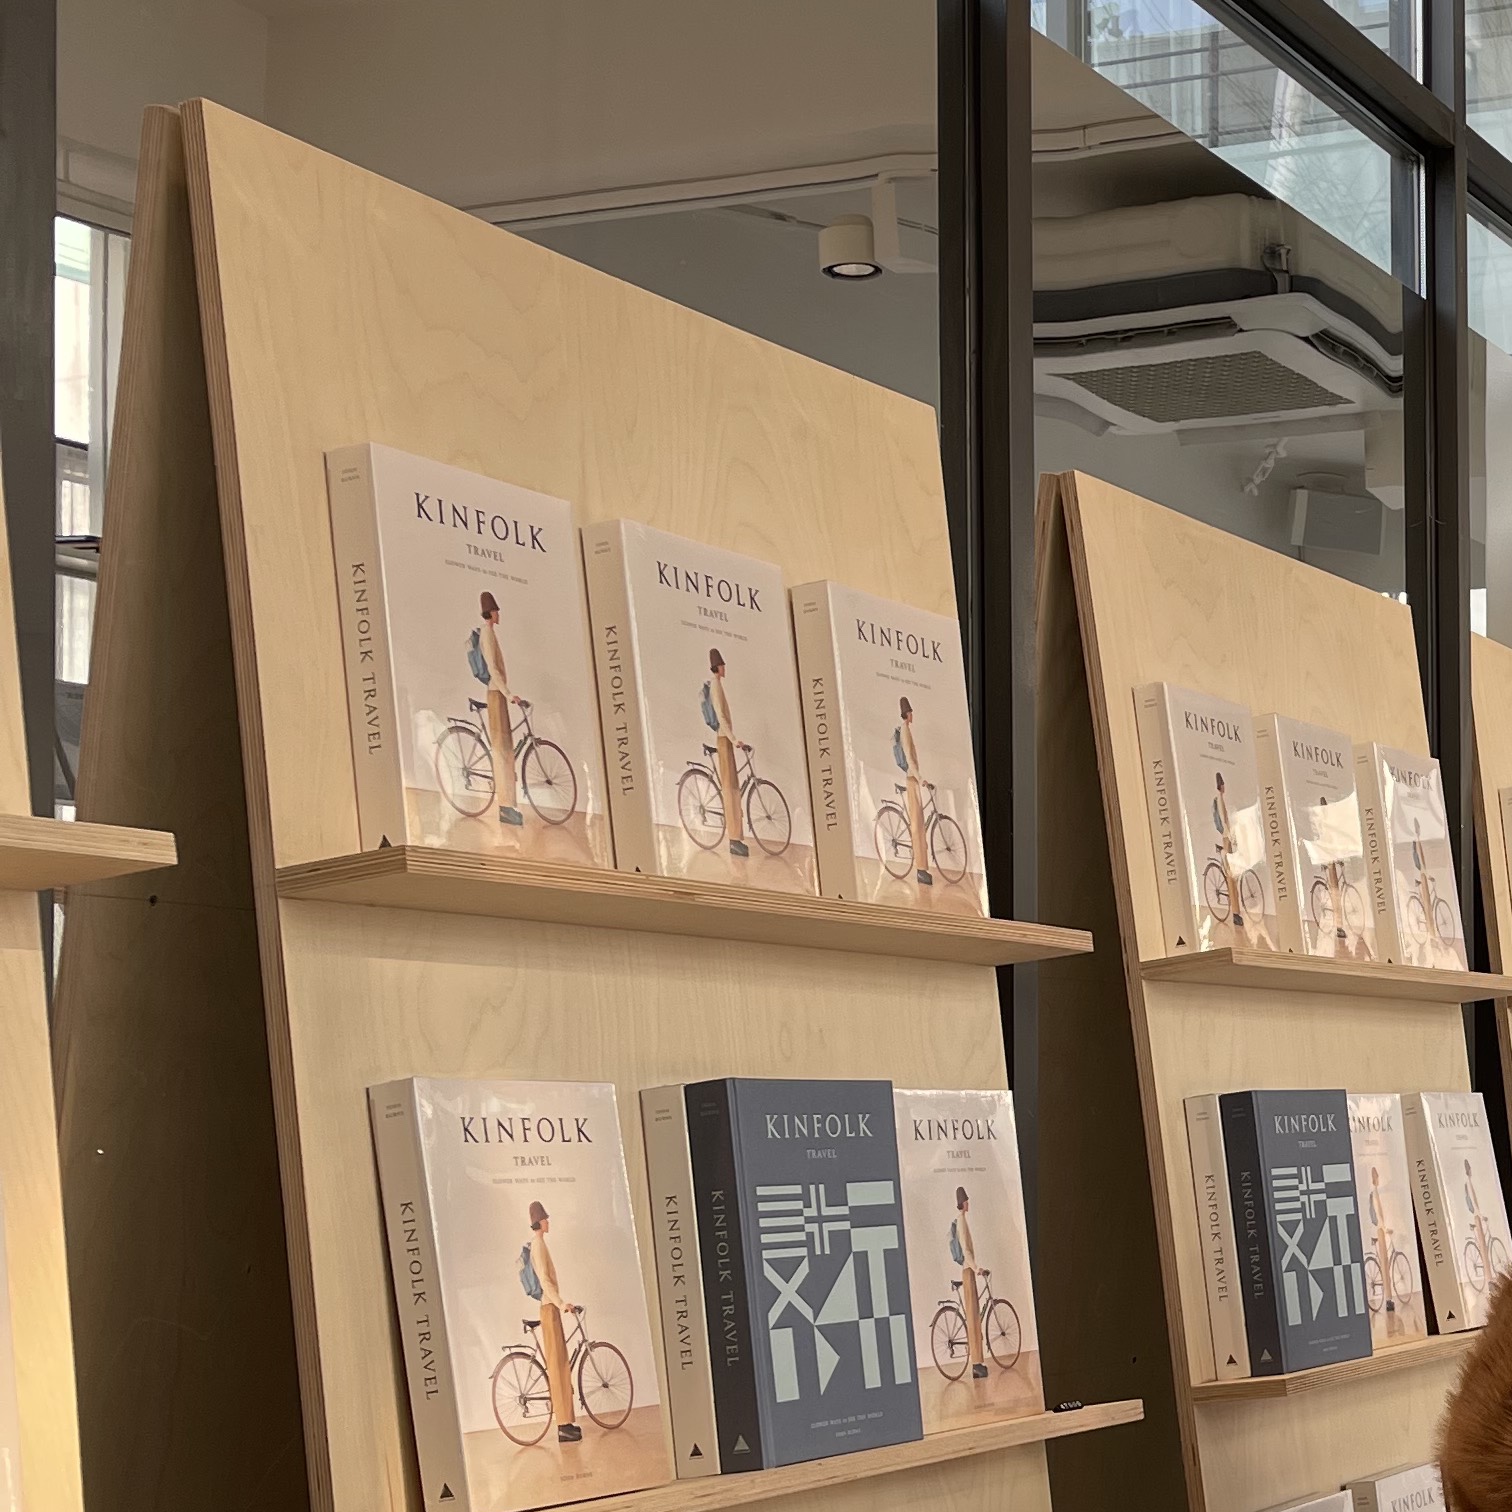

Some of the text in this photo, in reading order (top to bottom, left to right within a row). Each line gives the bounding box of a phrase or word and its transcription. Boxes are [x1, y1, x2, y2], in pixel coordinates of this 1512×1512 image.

[414, 492, 546, 553] KINFOLK
[466, 543, 504, 563] TRAVEL
[656, 560, 762, 612] KINFOLK
[697, 605, 729, 623] TRAVEL
[351, 562, 382, 755] KINFOLK TRAVEL
[855, 618, 943, 663] KINFOLK
[604, 625, 635, 797] KINFOLK TRAVEL
[1184, 710, 1241, 744] KINFOLK
[812, 677, 838, 832] KINFOLK TRAVEL
[1292, 740, 1344, 769] KINFOLK
[1152, 760, 1177, 885] KINFOLK TRAVEL
[1264, 786, 1288, 902] KINFOLK TRAVEL
[1365, 808, 1387, 915] KINFOLK TRAVEL
[460, 1116, 592, 1144] KINFOLK
[765, 1112, 873, 1139] KINFOLK
[914, 1118, 998, 1142] KINFOLK
[1274, 1113, 1337, 1135] KINFOLK
[1350, 1115, 1393, 1133] INFOLK
[513, 1156, 552, 1167] TRAVEL
[806, 1148, 837, 1159] TRAVEL
[1205, 1174, 1229, 1302] KINFOLK TRAVEL
[1240, 1170, 1265, 1299] KINFOLK TRAVEL
[1416, 1159, 1444, 1267] KINFOLK TRAVEL
[400, 1201, 439, 1401] KINFOLK TRAVEL
[665, 1194, 694, 1372] KINFOLK TRAVEL
[711, 1189, 740, 1368] KINFOLK TRAVEL
